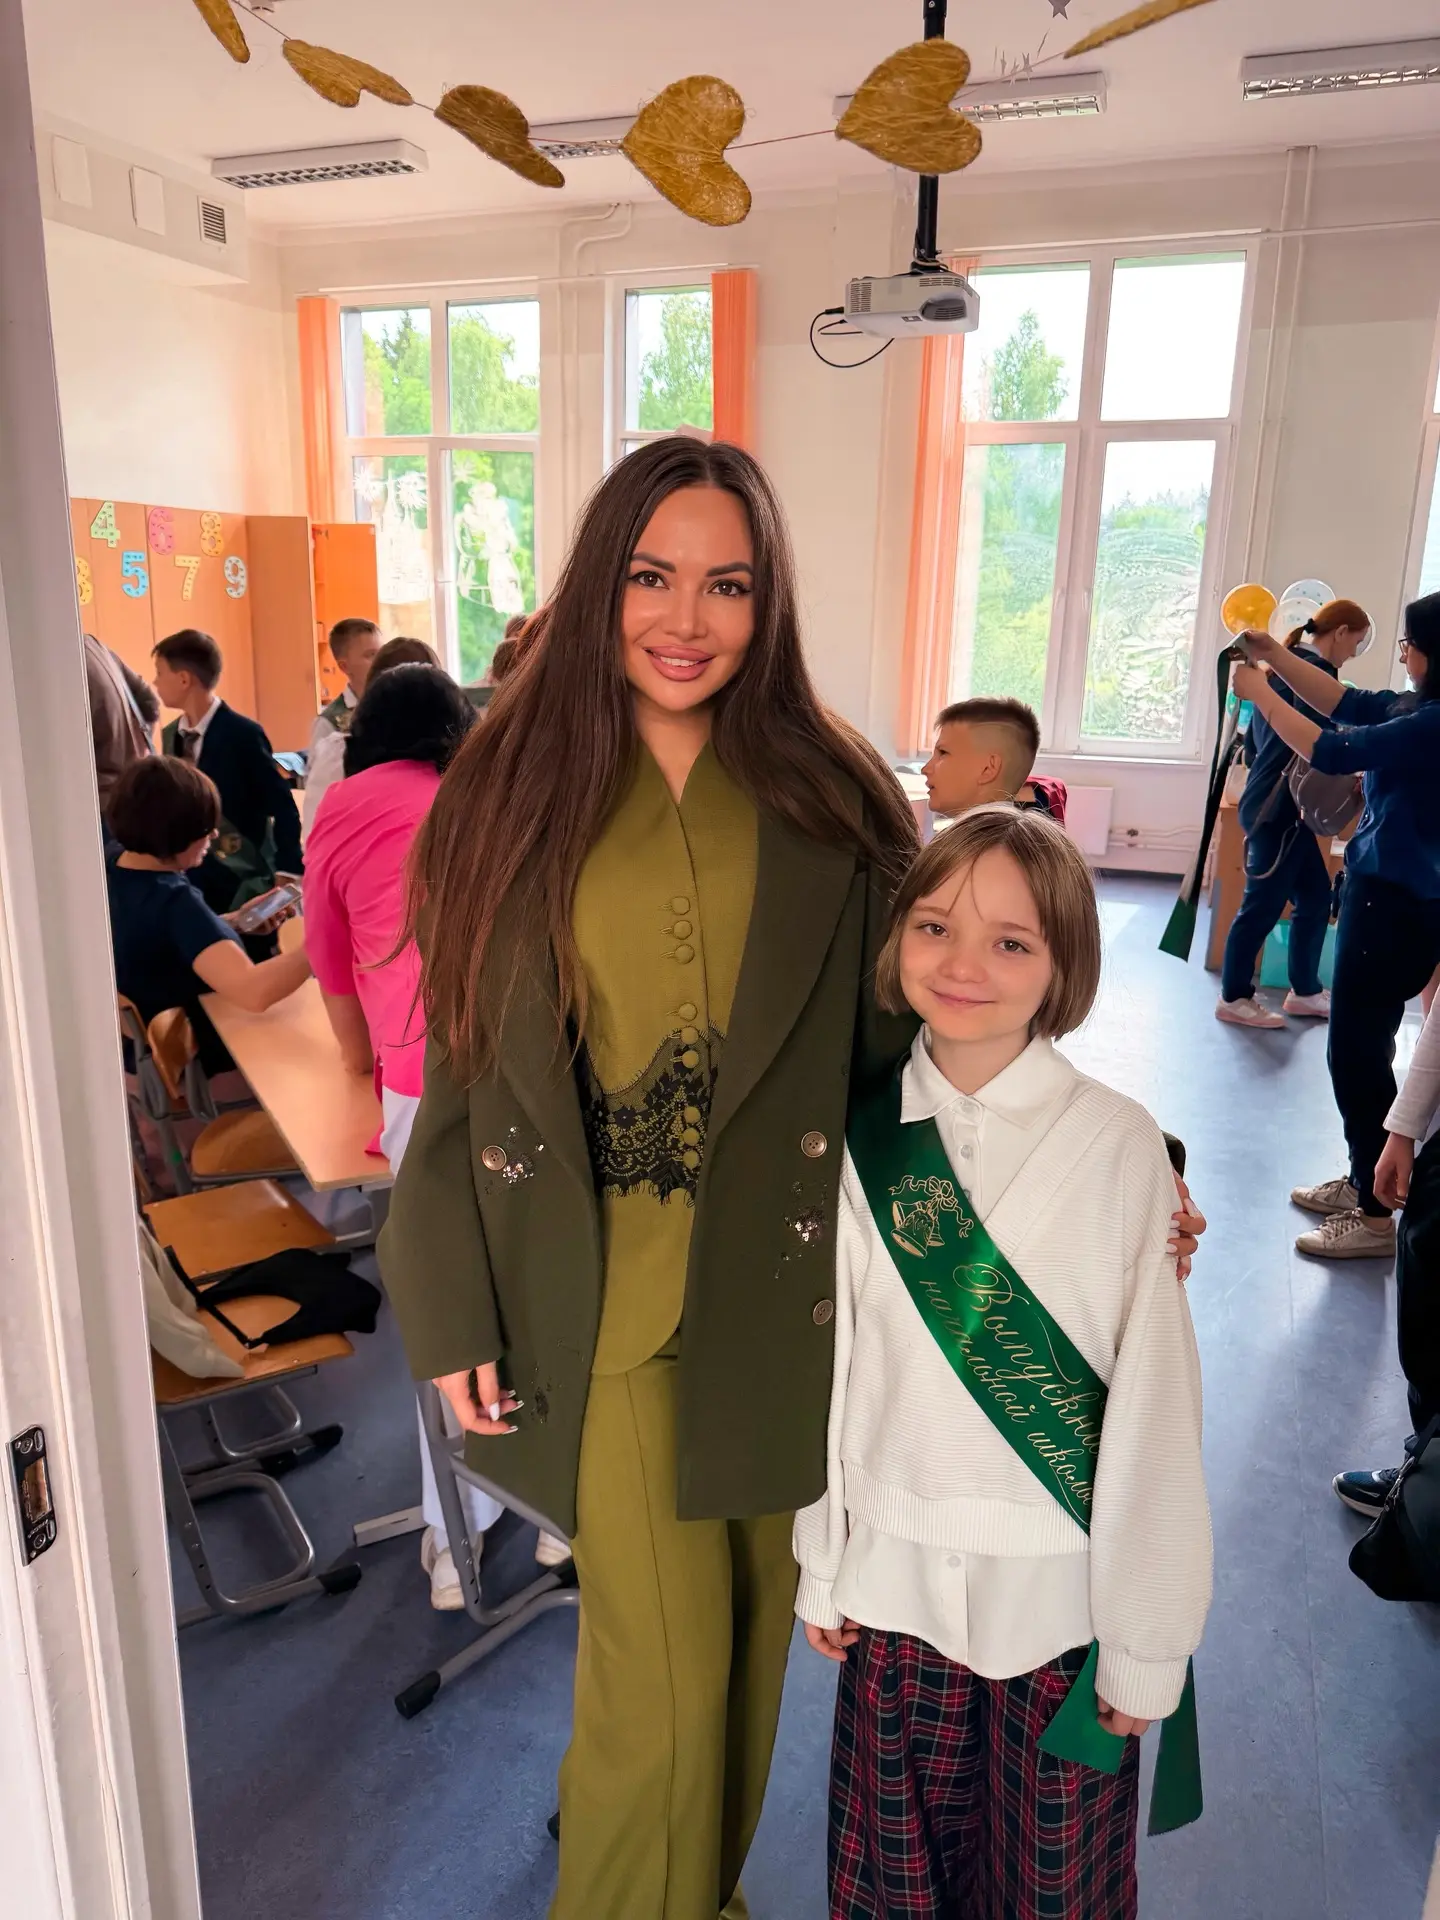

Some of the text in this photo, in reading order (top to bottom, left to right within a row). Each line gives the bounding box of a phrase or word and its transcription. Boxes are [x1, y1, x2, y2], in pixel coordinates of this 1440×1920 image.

[90, 500, 225, 557] 4 6 8
[122, 551, 149, 598] 5
[174, 554, 200, 600] 7
[224, 555, 247, 599] 9
